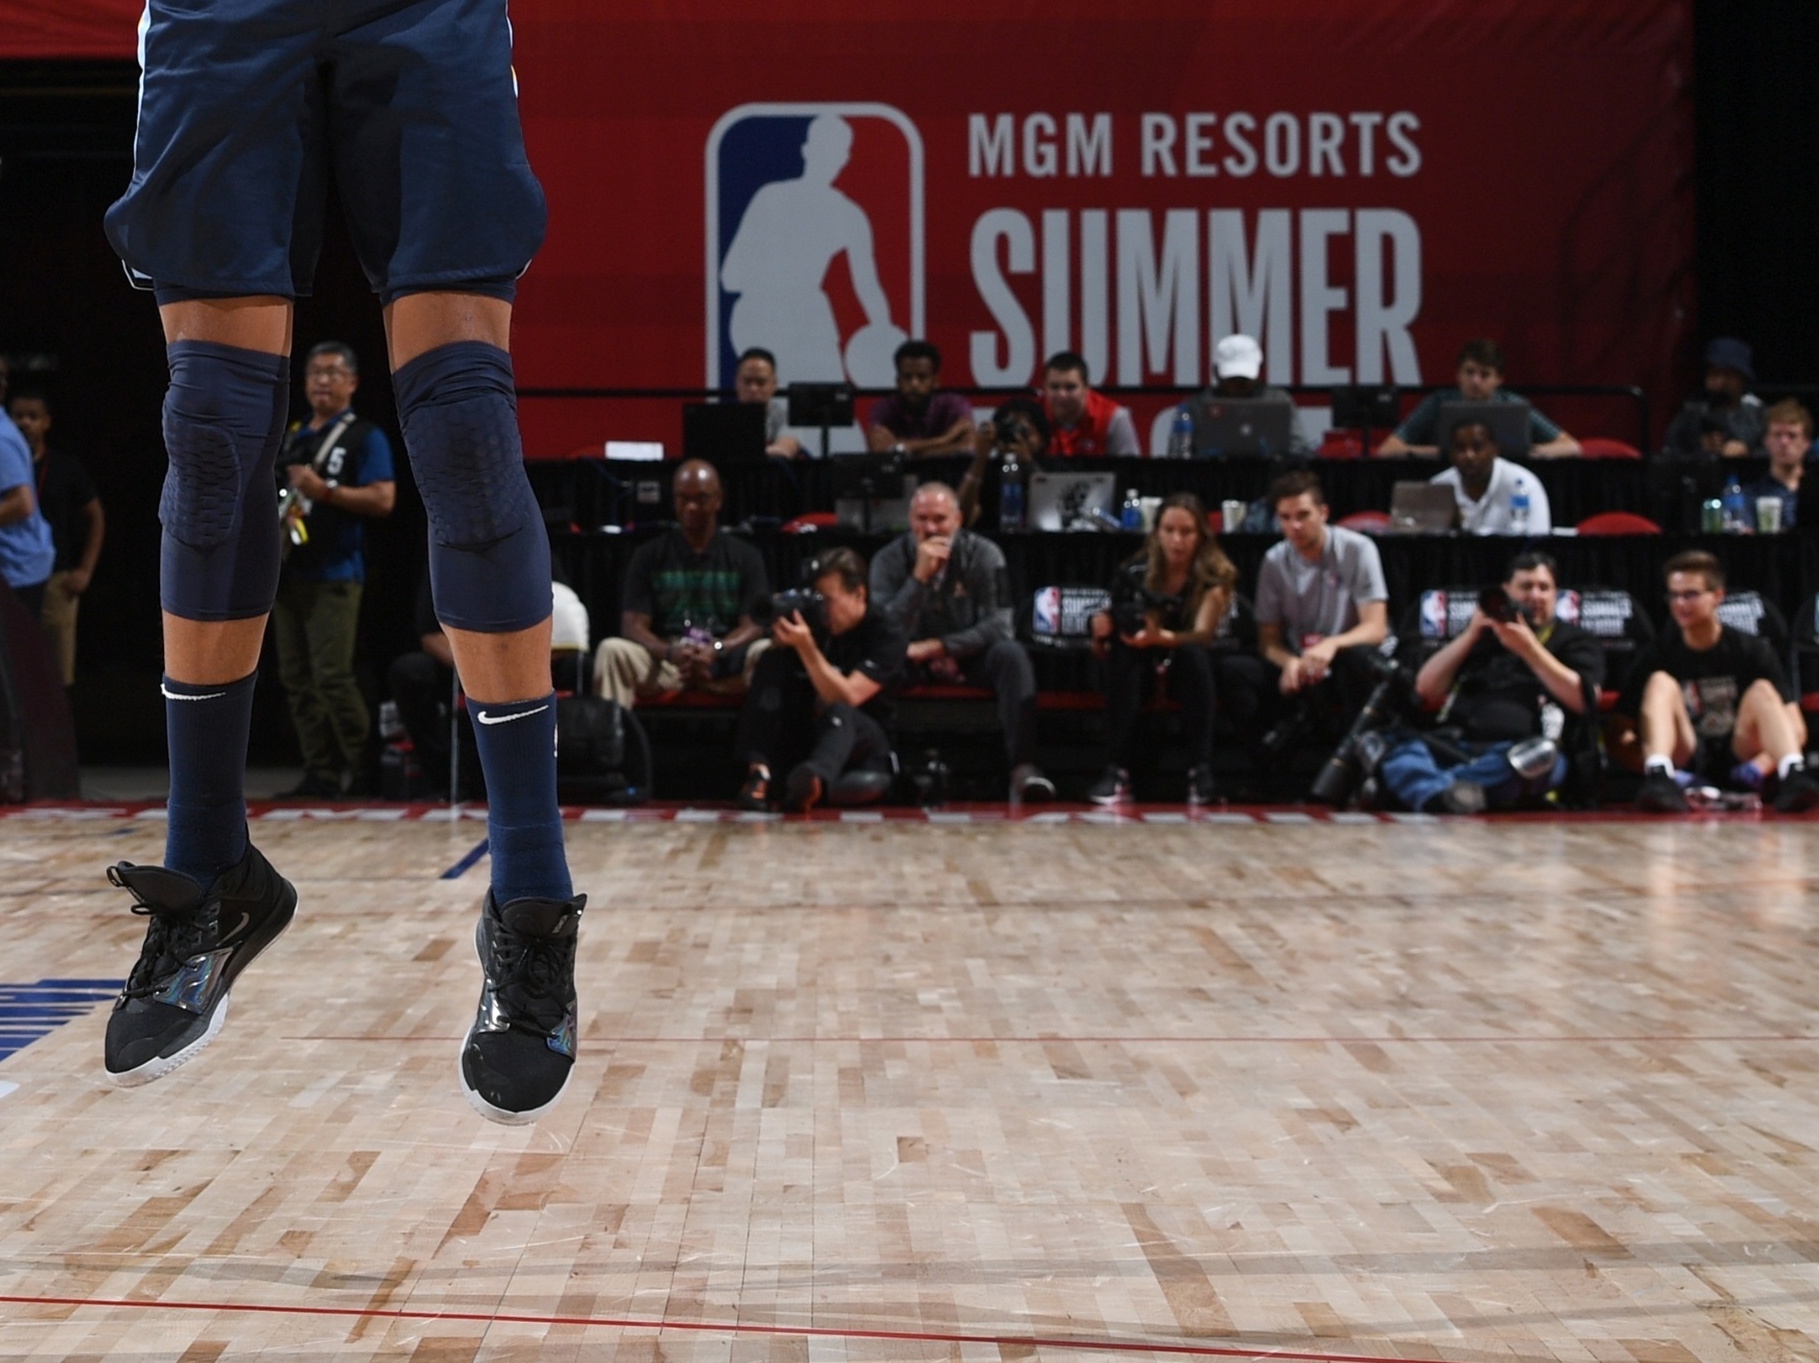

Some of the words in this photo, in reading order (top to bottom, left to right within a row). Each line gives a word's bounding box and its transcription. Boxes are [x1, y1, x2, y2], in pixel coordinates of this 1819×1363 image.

[969, 112, 1114, 178] MGM
[1140, 111, 1424, 179] RESORTS
[969, 207, 1424, 389] SUMMER
